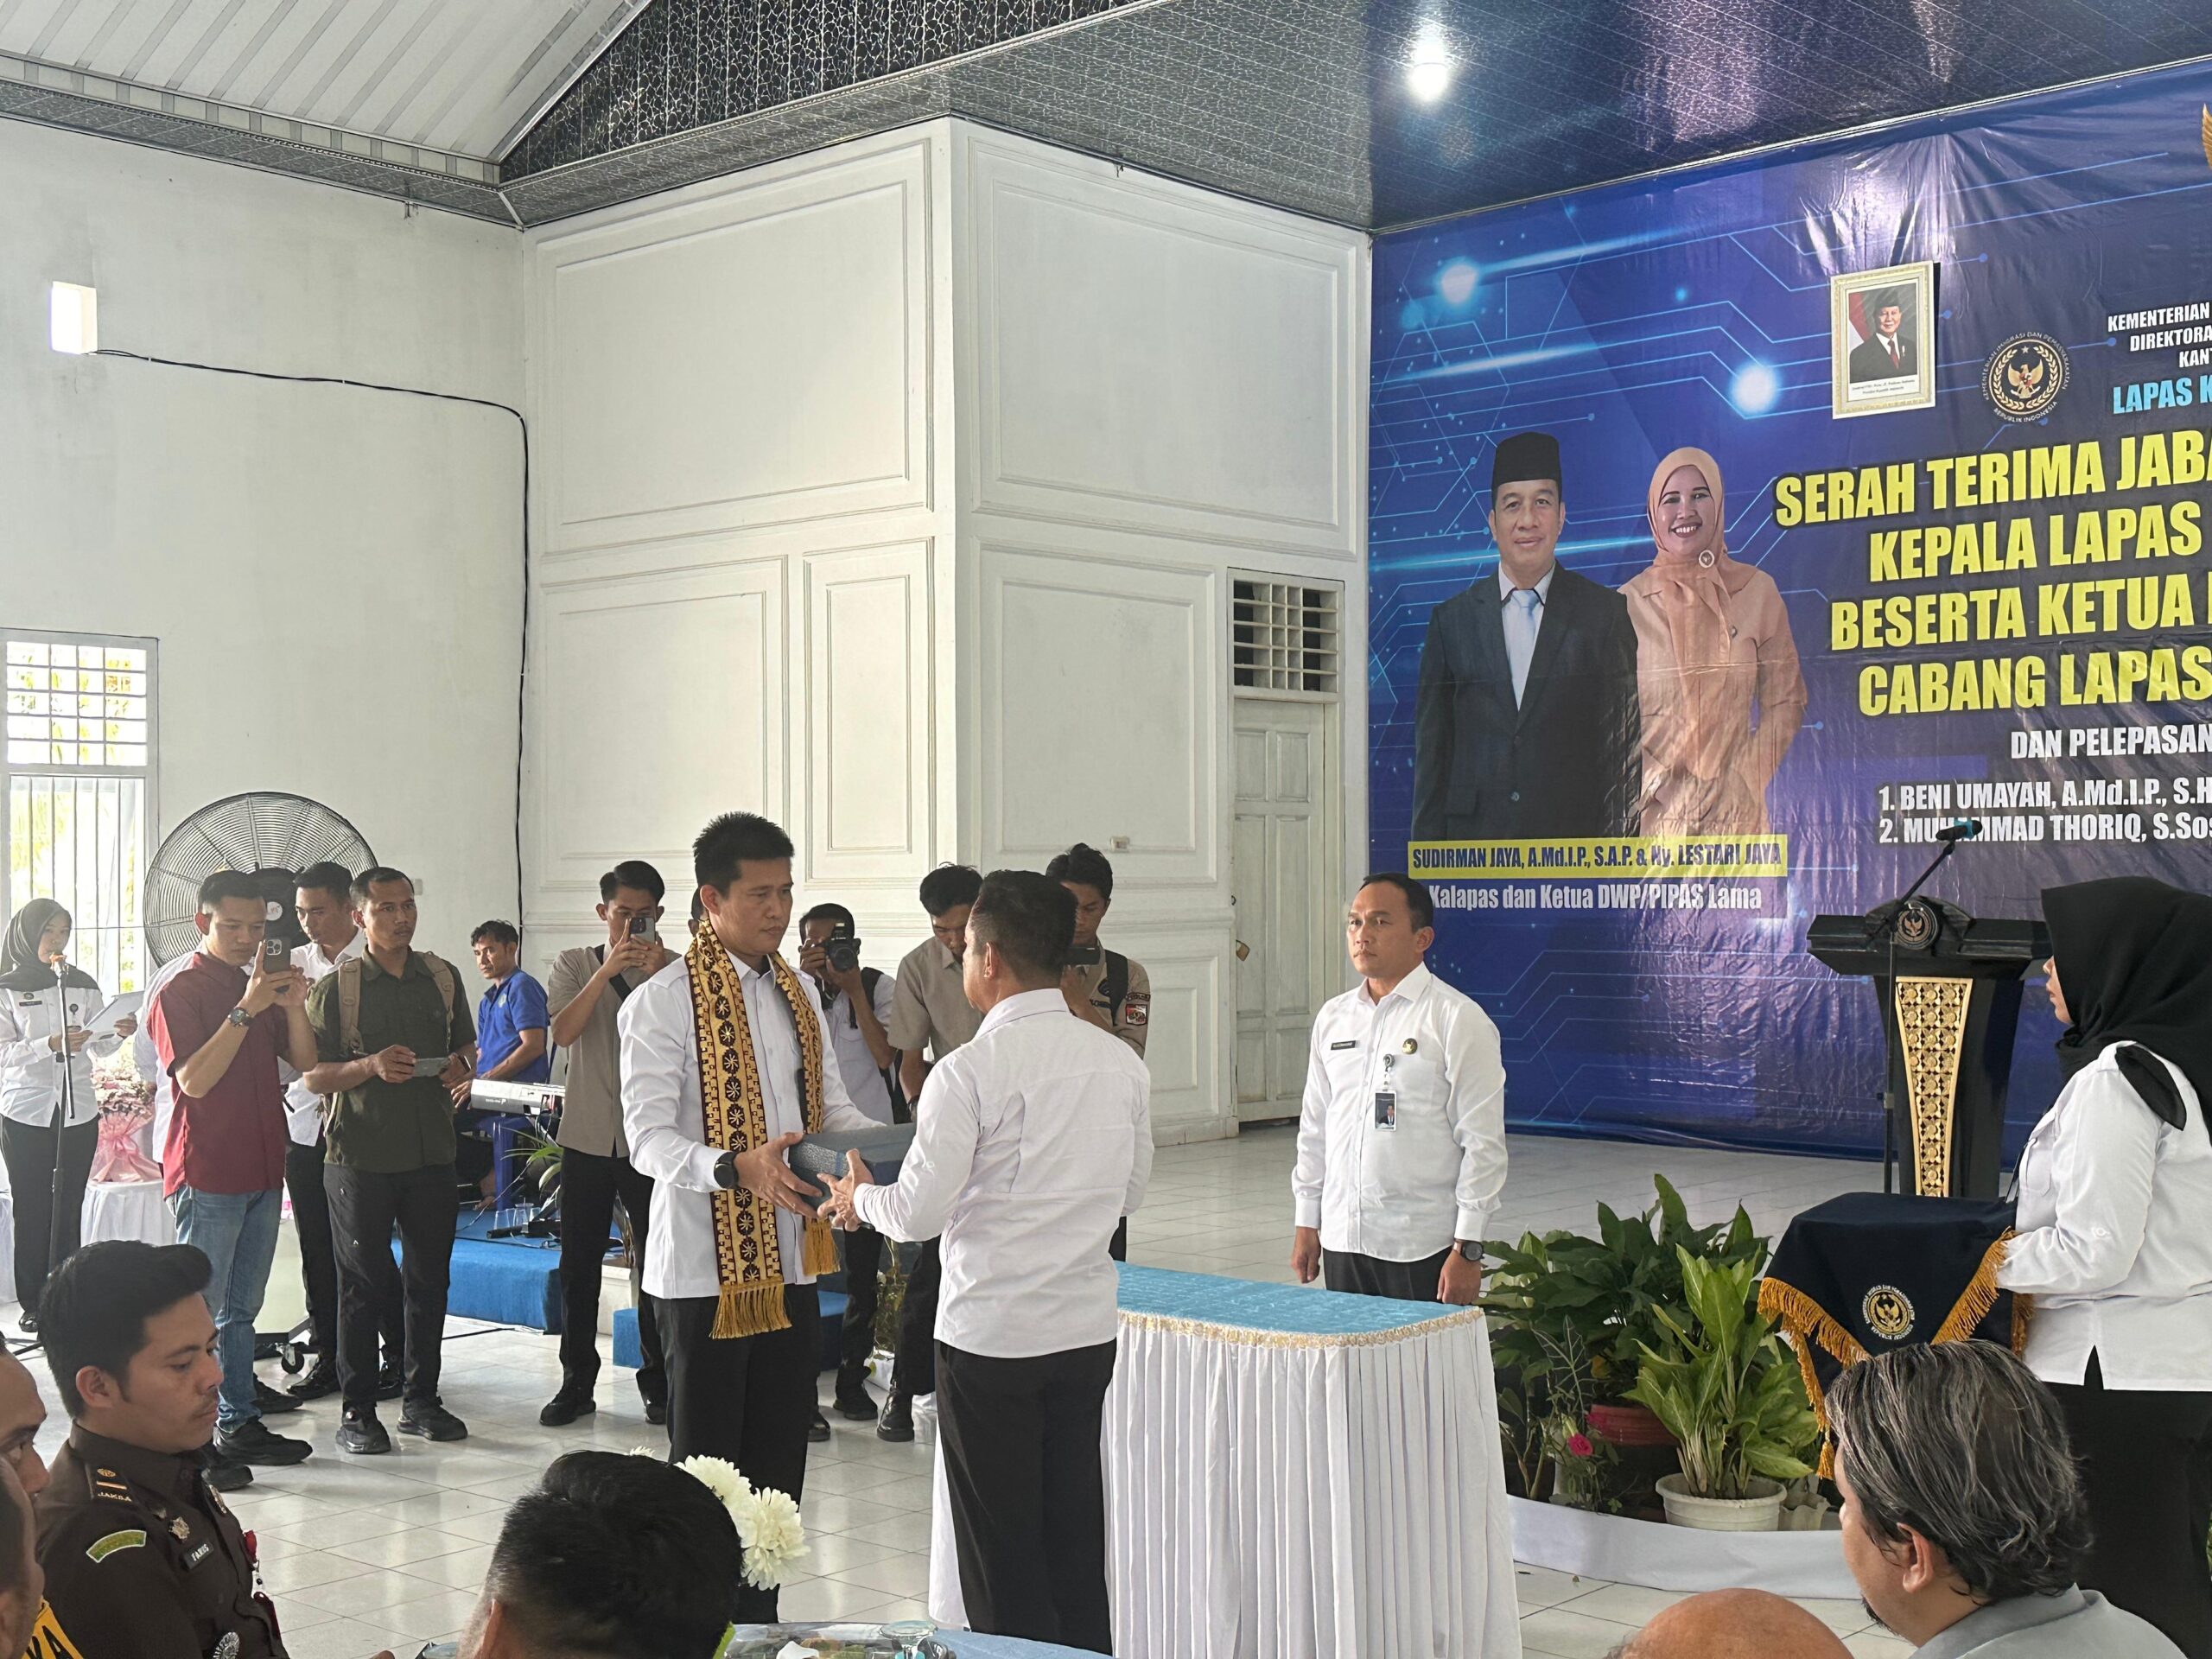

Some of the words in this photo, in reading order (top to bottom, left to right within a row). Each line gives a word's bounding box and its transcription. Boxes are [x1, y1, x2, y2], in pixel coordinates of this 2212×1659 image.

[2107, 302, 2210, 333] KEMENTERIAN
[2113, 377, 2193, 415] LAPAS
[1775, 461, 1916, 527] SERAH
[1927, 441, 2106, 510] TERIMA
[2116, 429, 2212, 491] JAB
[1869, 517, 2038, 583] KEPALA
[2049, 500, 2202, 567] LAPAS
[1831, 587, 2027, 651] BESERTA
[2038, 573, 2195, 637] KETUA
[1859, 655, 2046, 716] CABANG
[2060, 645, 2212, 707] LAPAS
[2011, 729, 2062, 760] DAN
[2069, 723, 2212, 757] PELEPASAN
[1878, 785, 1895, 811] 1.
[1900, 784, 1951, 810] BENI
[1956, 781, 2056, 810] UMAYAH,
[2062, 779, 2167, 808] A.Md.I.P.,
[2173, 777, 2212, 804] S.H
[1879, 818, 1898, 843] 2.
[1904, 815, 2044, 843] MUMMAD
[2050, 813, 2147, 842] THORIQ,
[1413, 848, 1486, 868] SUDIRMAN
[1490, 847, 1525, 869] JAYA,
[1594, 845, 1632, 867] S.A.P.
[1636, 848, 1647, 867] &
[1651, 844, 1675, 868] Ny.
[1678, 843, 1740, 866] LESTARI
[1745, 842, 1782, 865] JAYA
[1428, 885, 1499, 911] Kalapas
[1503, 885, 1535, 909] dan
[1541, 884, 1593, 909] Ketua
[1599, 883, 1704, 909] DWP/PIPAS
[1709, 883, 1762, 910] Lama
